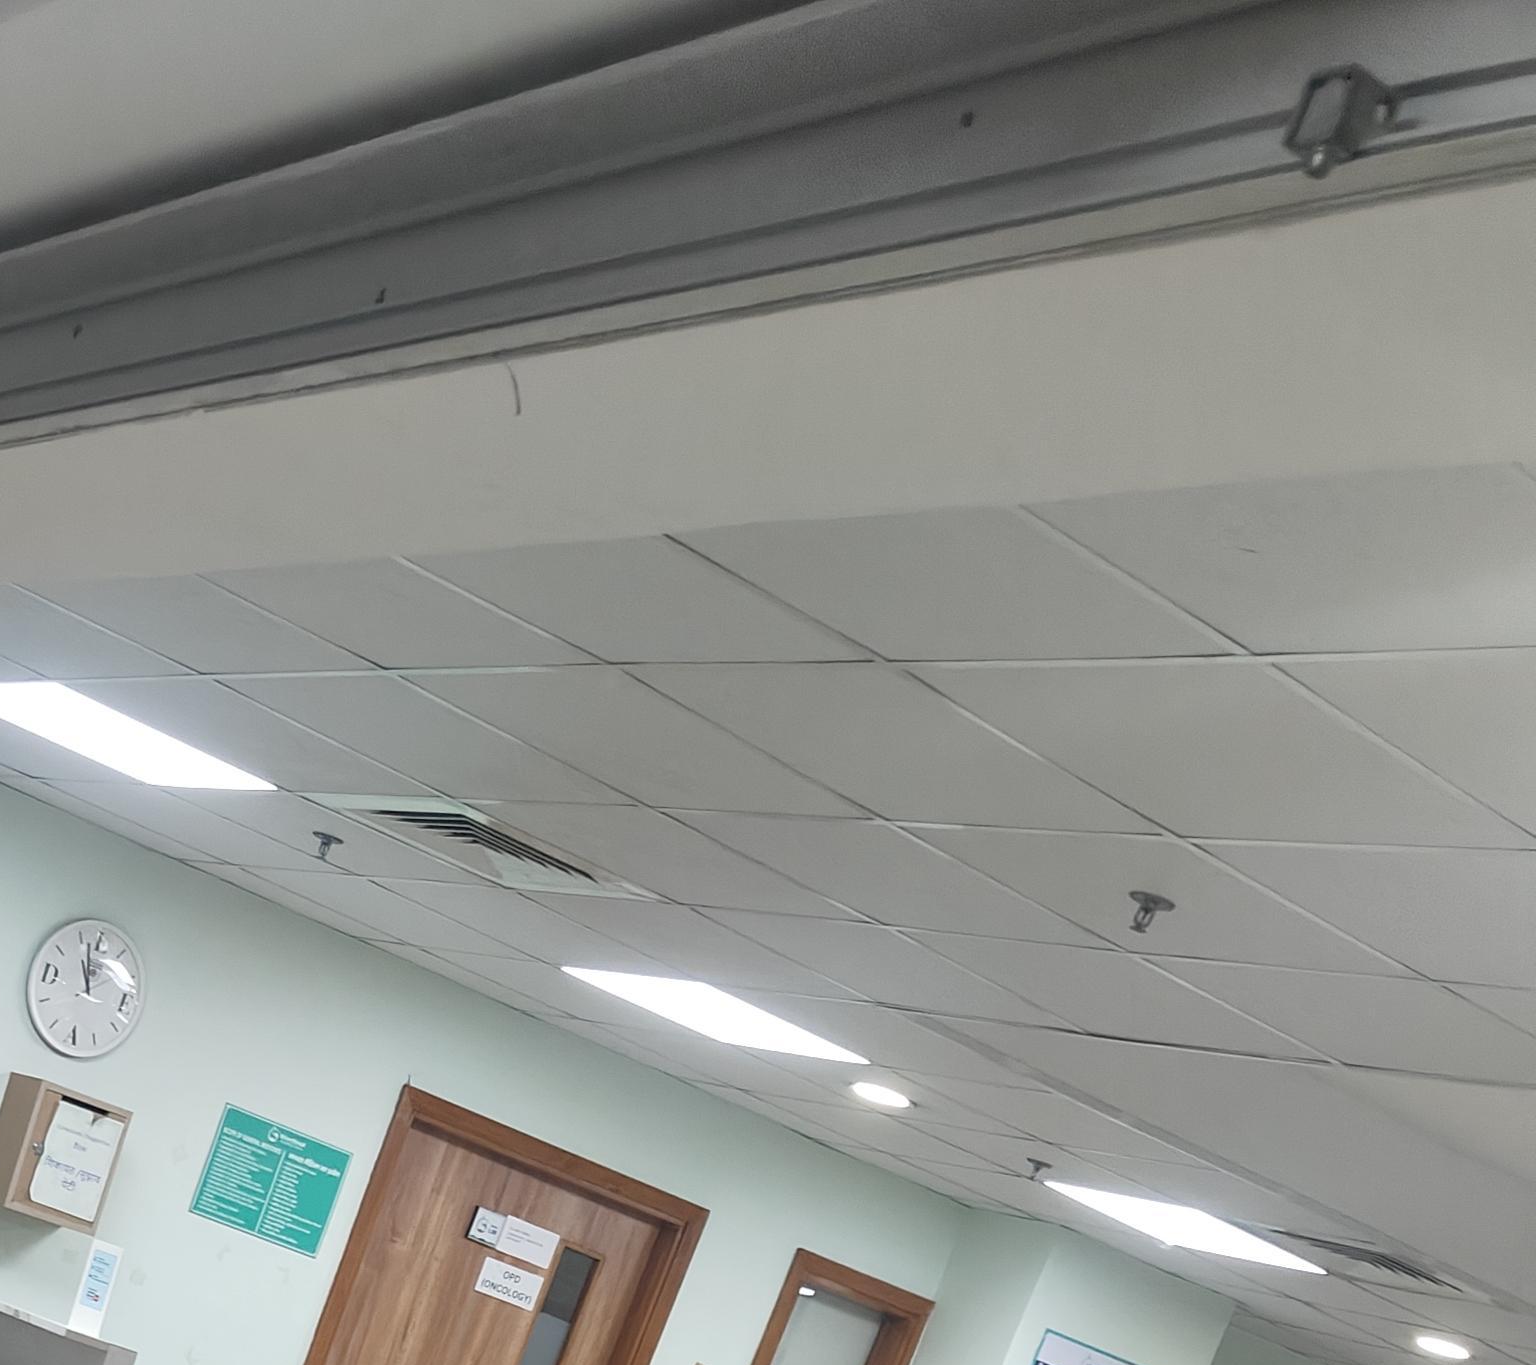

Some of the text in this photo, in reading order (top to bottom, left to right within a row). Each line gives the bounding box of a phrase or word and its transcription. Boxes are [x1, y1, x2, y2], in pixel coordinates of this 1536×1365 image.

[41, 962, 59, 985] D
[503, 1271, 521, 1284] OPD
[480, 1278, 532, 1304] (ONCOLOGY)
